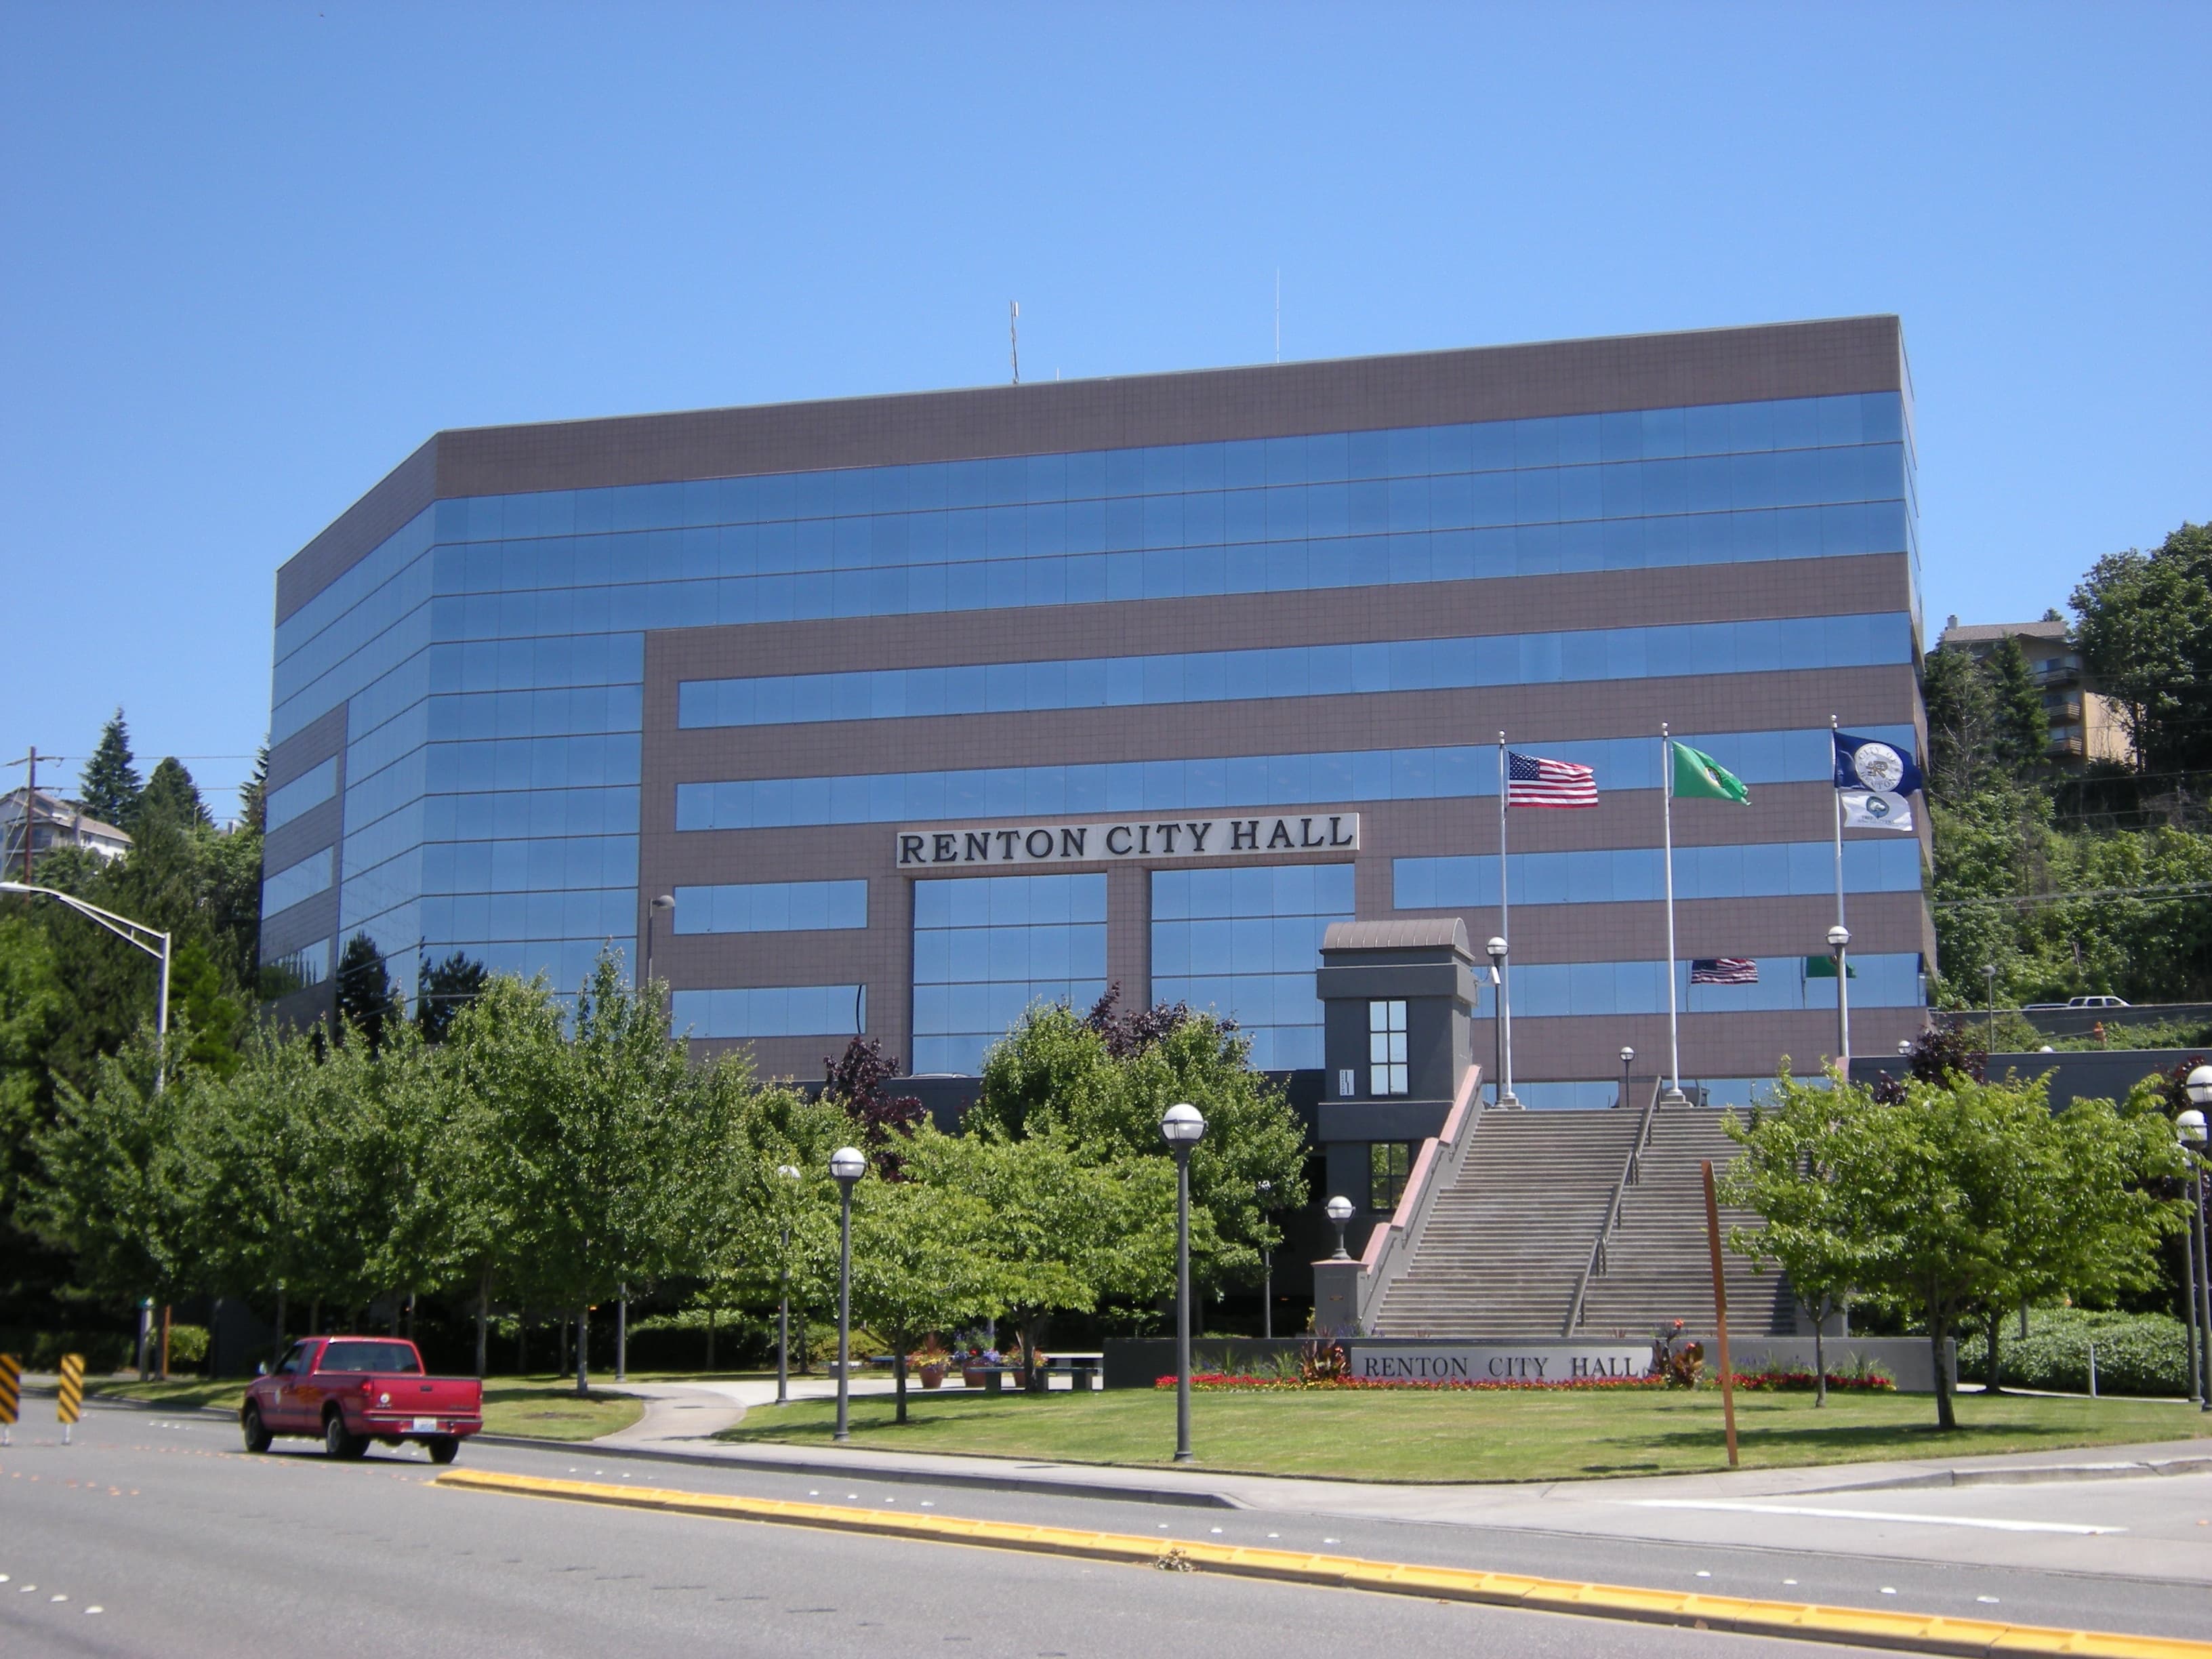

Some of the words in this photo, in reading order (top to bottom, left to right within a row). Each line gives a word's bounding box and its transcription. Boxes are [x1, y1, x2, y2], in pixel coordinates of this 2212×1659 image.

[900, 829, 1087, 864] RENTON
[1106, 822, 1212, 855] CITY
[1231, 817, 1353, 850] HALL
[1364, 1357, 1468, 1378] RENTON
[1488, 1357, 1549, 1378] CITY
[1571, 1357, 1639, 1378] HALL
